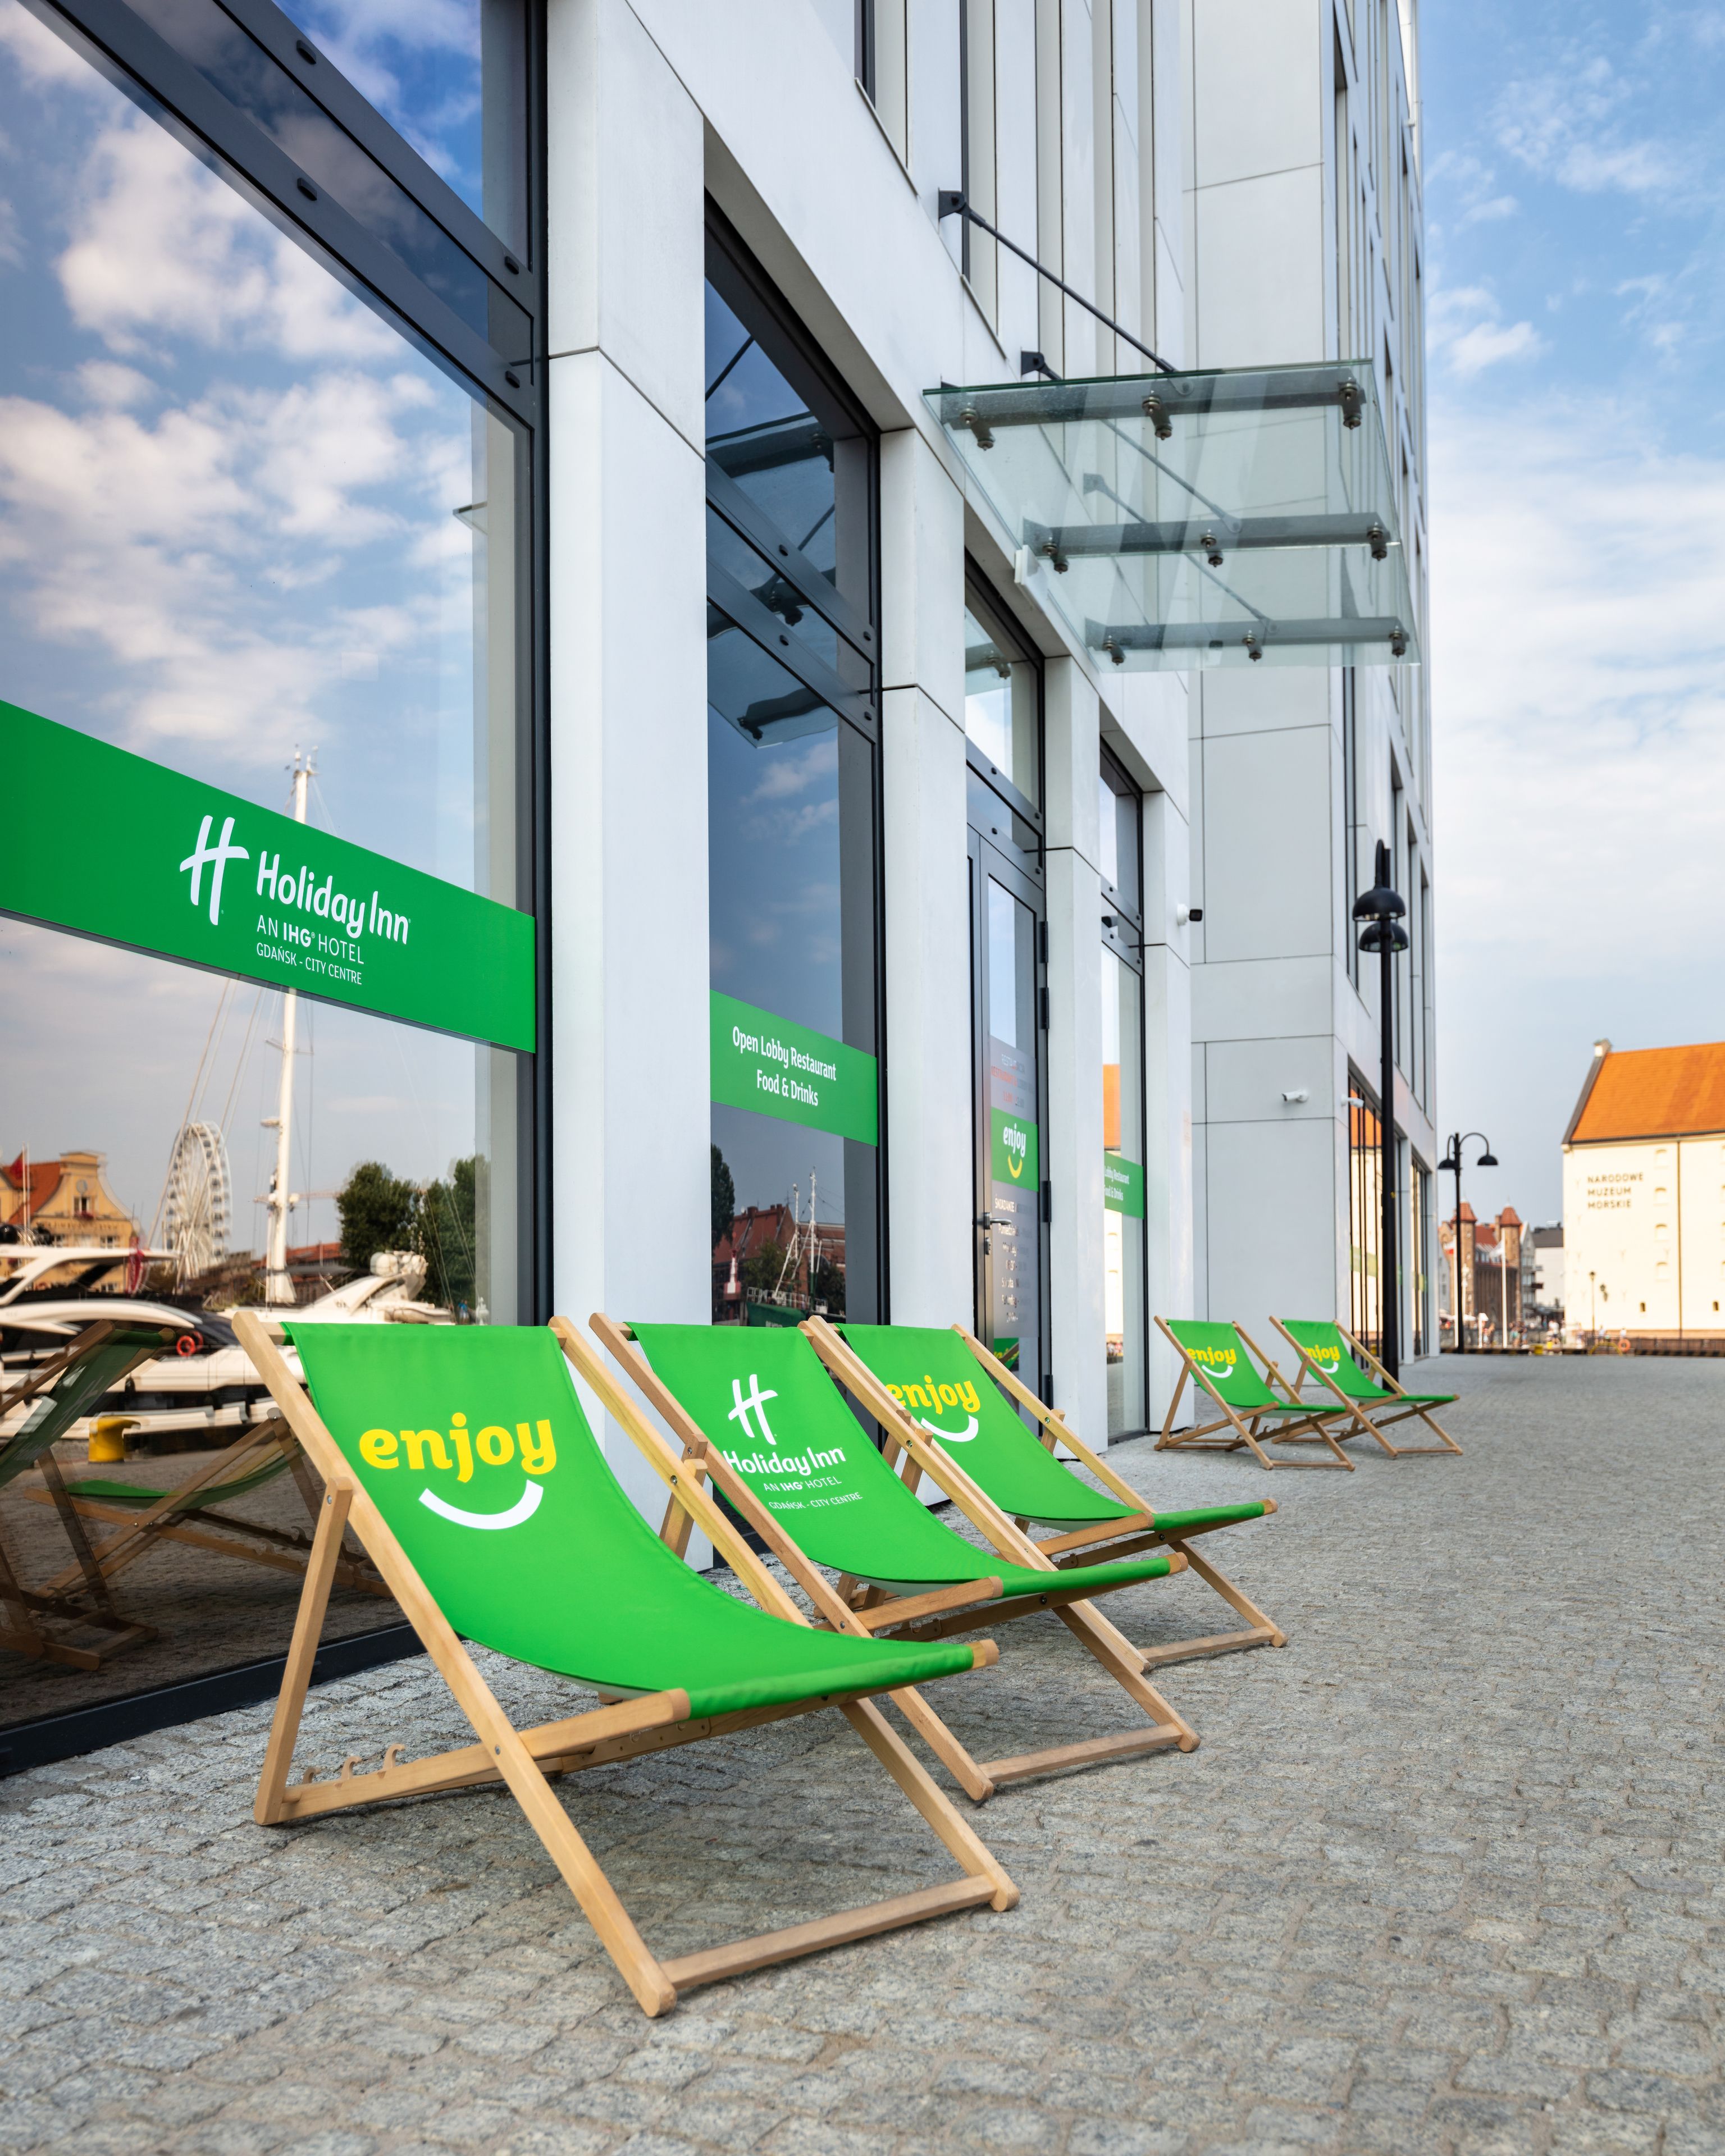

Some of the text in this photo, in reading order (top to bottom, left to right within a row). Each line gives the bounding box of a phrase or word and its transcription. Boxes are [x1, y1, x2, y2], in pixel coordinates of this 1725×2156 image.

[257, 851, 365, 938] Holiday
[257, 915, 278, 938] AN
[318, 933, 364, 965] HOTEL
[257, 942, 297, 966] GDAŃSK
[305, 957, 326, 974] CITY
[328, 963, 362, 985] CENTRE
[733, 1026, 836, 1081] Open Lobby Restaurant
[757, 1069, 818, 1107] Food & Drinks
[1003, 1123, 1026, 1158] enjoy
[1587, 1172, 1643, 1182] NARODOWE
[1587, 1187, 1631, 1196] MUZEUM
[1587, 1199, 1631, 1208] MORSKIE
[1305, 1344, 1340, 1362] njoy
[885, 1375, 980, 1415] enjoy
[359, 1412, 556, 1483] enjoy
[723, 1450, 811, 1476] Holiday
[763, 1483, 781, 1491] AN
[805, 1476, 842, 1489] HOTEL
[769, 1501, 806, 1510] GDAŃSK
[810, 1498, 830, 1508] CITY
[830, 1492, 863, 1505] CENTRE
